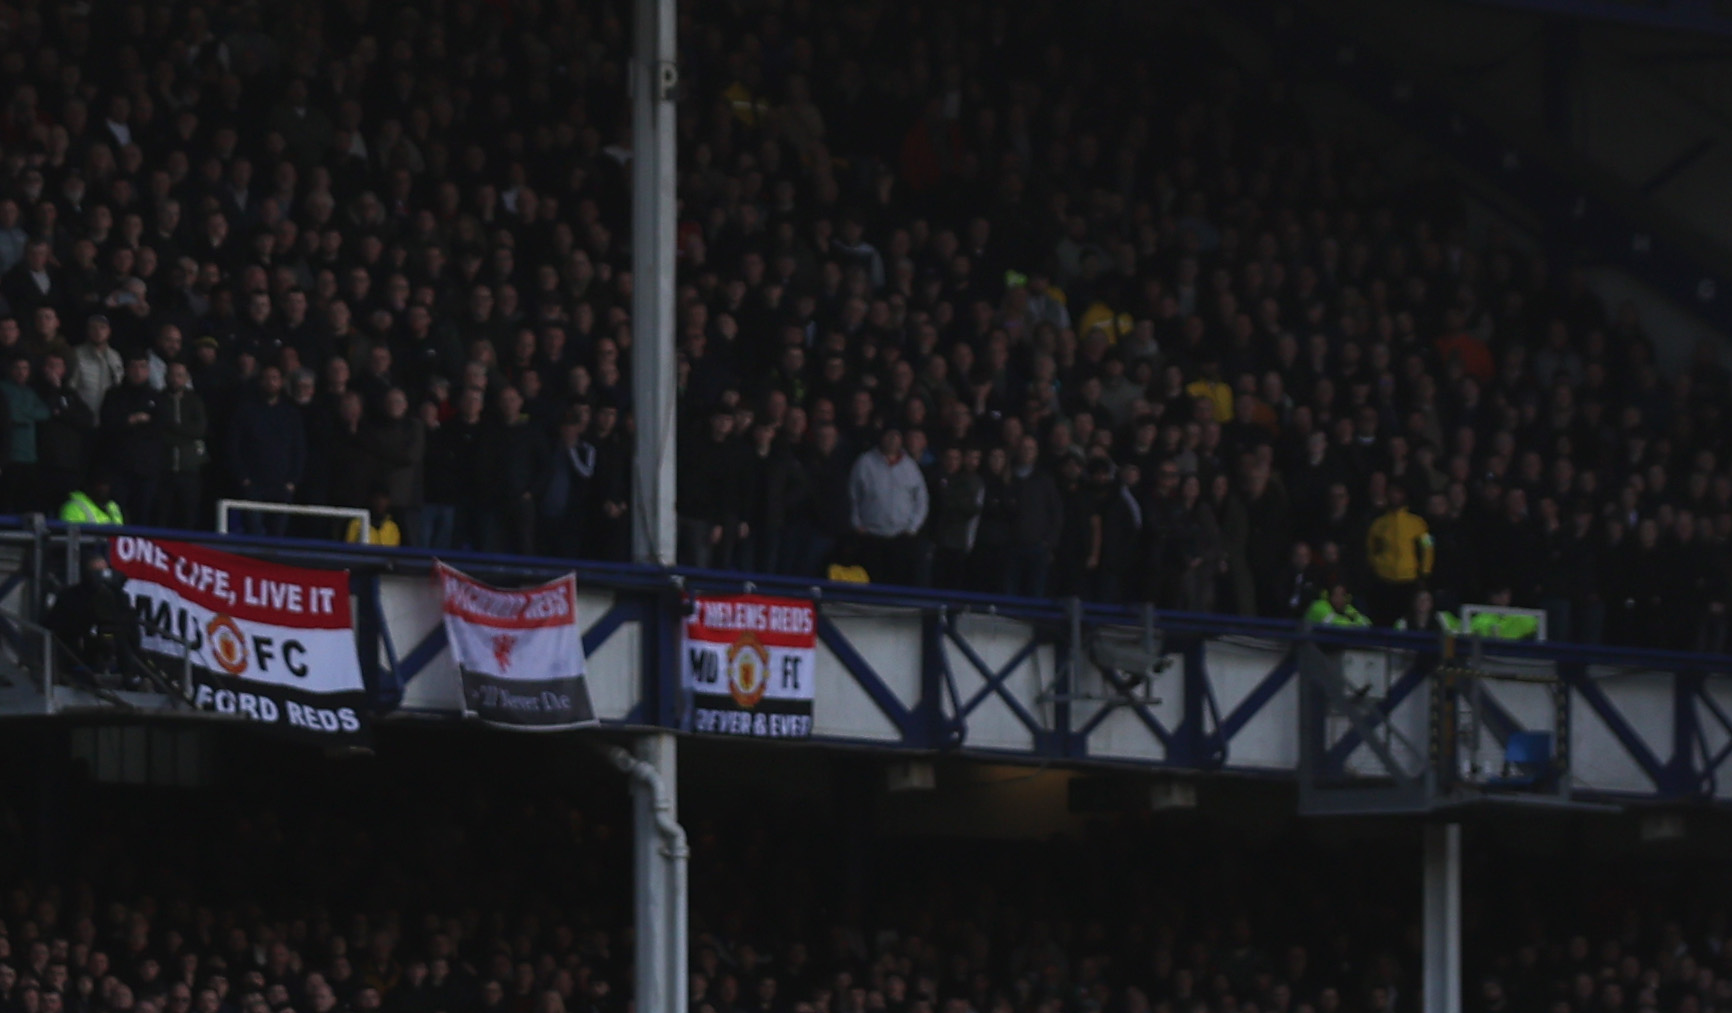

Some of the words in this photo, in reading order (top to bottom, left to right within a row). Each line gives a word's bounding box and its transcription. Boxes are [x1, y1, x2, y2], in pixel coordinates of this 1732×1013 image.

[115, 536, 170, 573] ONE
[243, 576, 304, 614] LIVE
[309, 586, 336, 615] IT
[769, 604, 814, 636] REDS
[284, 699, 362, 733] REDS
